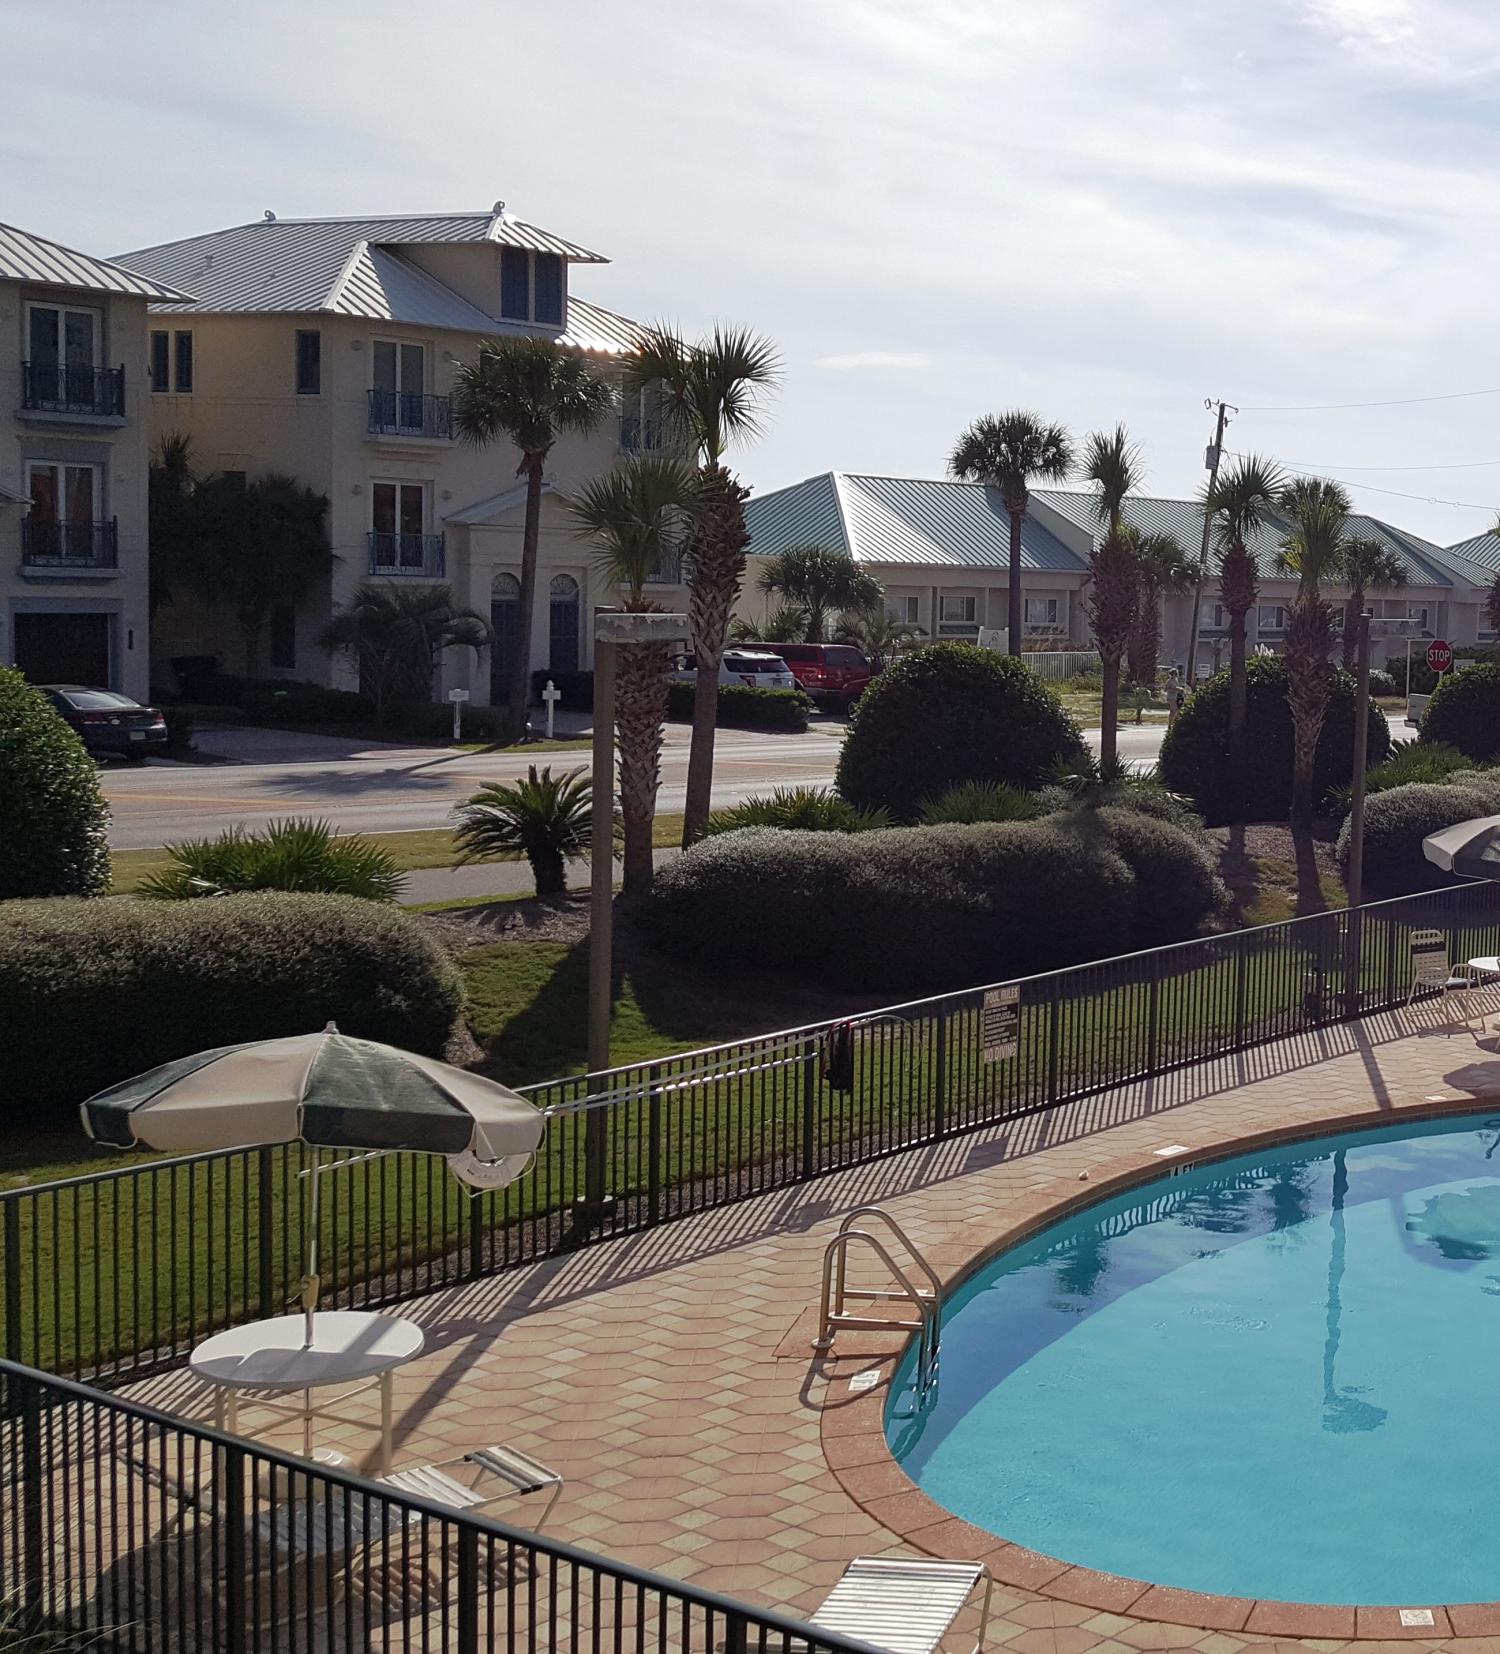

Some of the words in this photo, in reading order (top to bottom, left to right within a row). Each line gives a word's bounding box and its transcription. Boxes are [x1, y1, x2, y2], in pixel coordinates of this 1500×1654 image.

[1428, 649, 1450, 662] STOP
[984, 991, 1000, 1003] POOL
[1001, 987, 1018, 1000] RULES
[994, 1042, 1017, 1060] DIVING
